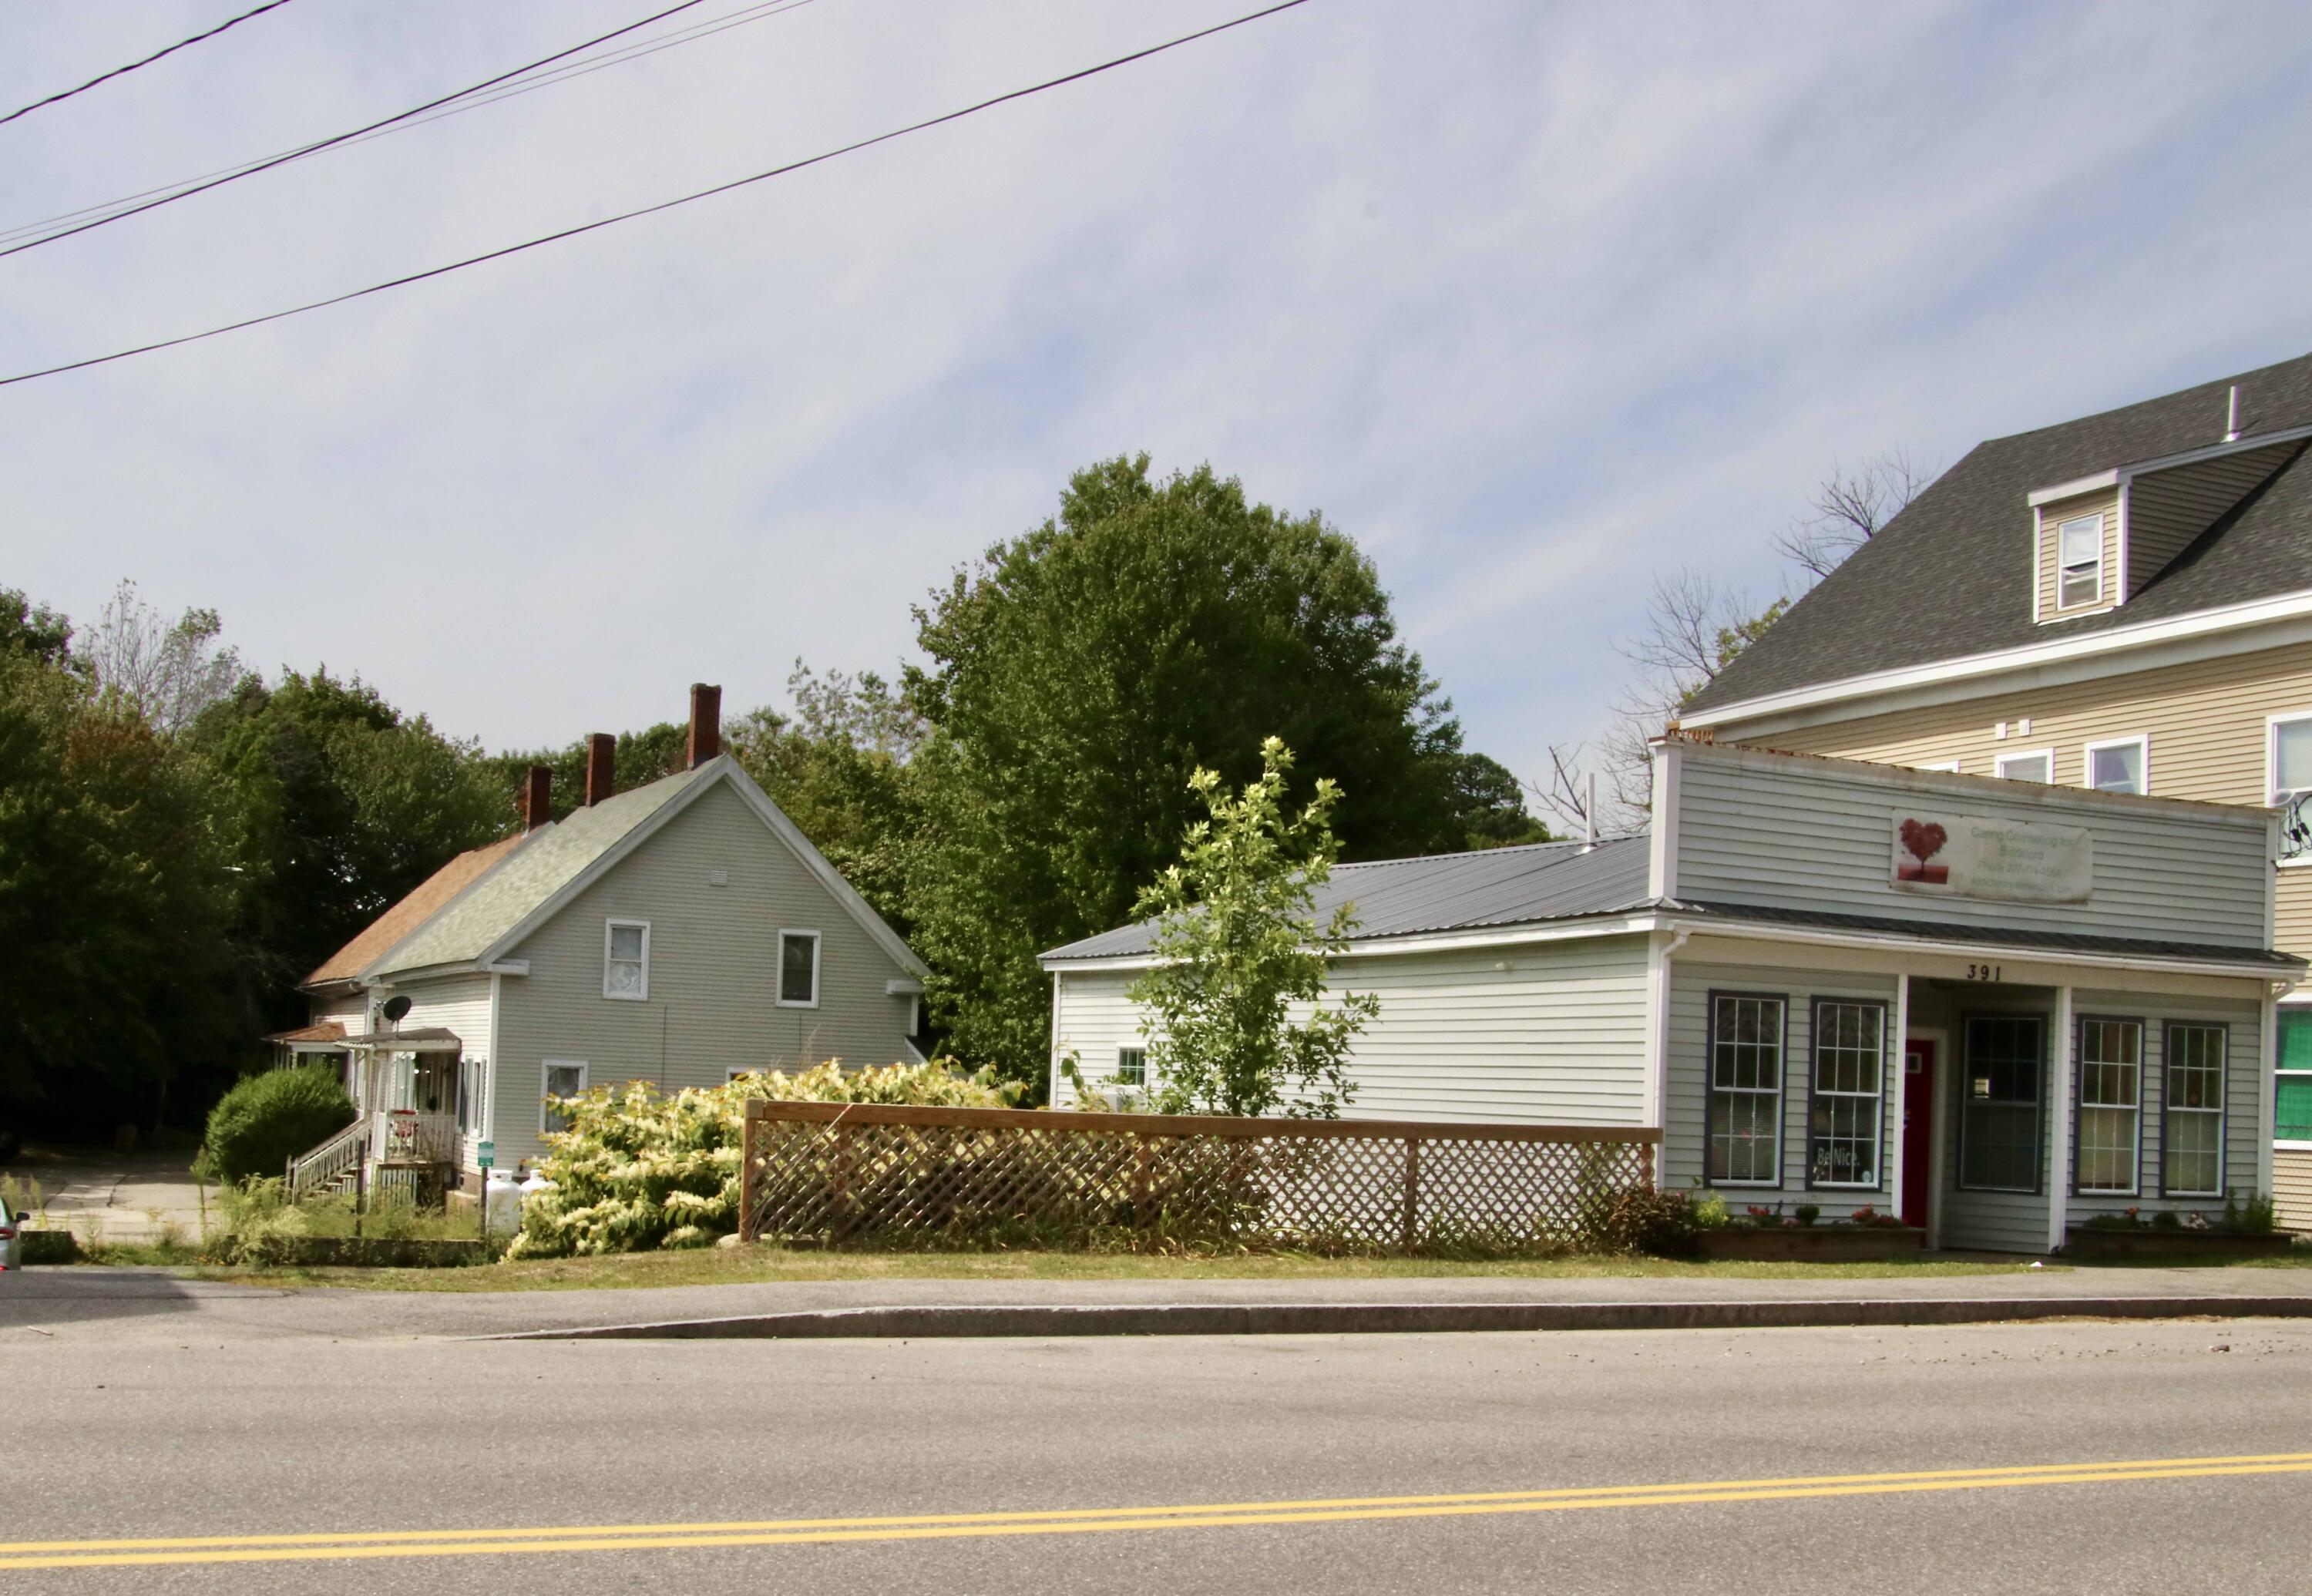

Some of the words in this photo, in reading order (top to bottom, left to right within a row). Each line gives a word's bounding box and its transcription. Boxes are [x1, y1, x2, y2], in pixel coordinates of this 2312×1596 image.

[1971, 826, 2003, 843] Caring
[1967, 964, 2001, 981] 391
[1817, 1147, 1831, 1166] Be
[1834, 1147, 1860, 1166] Nice.
